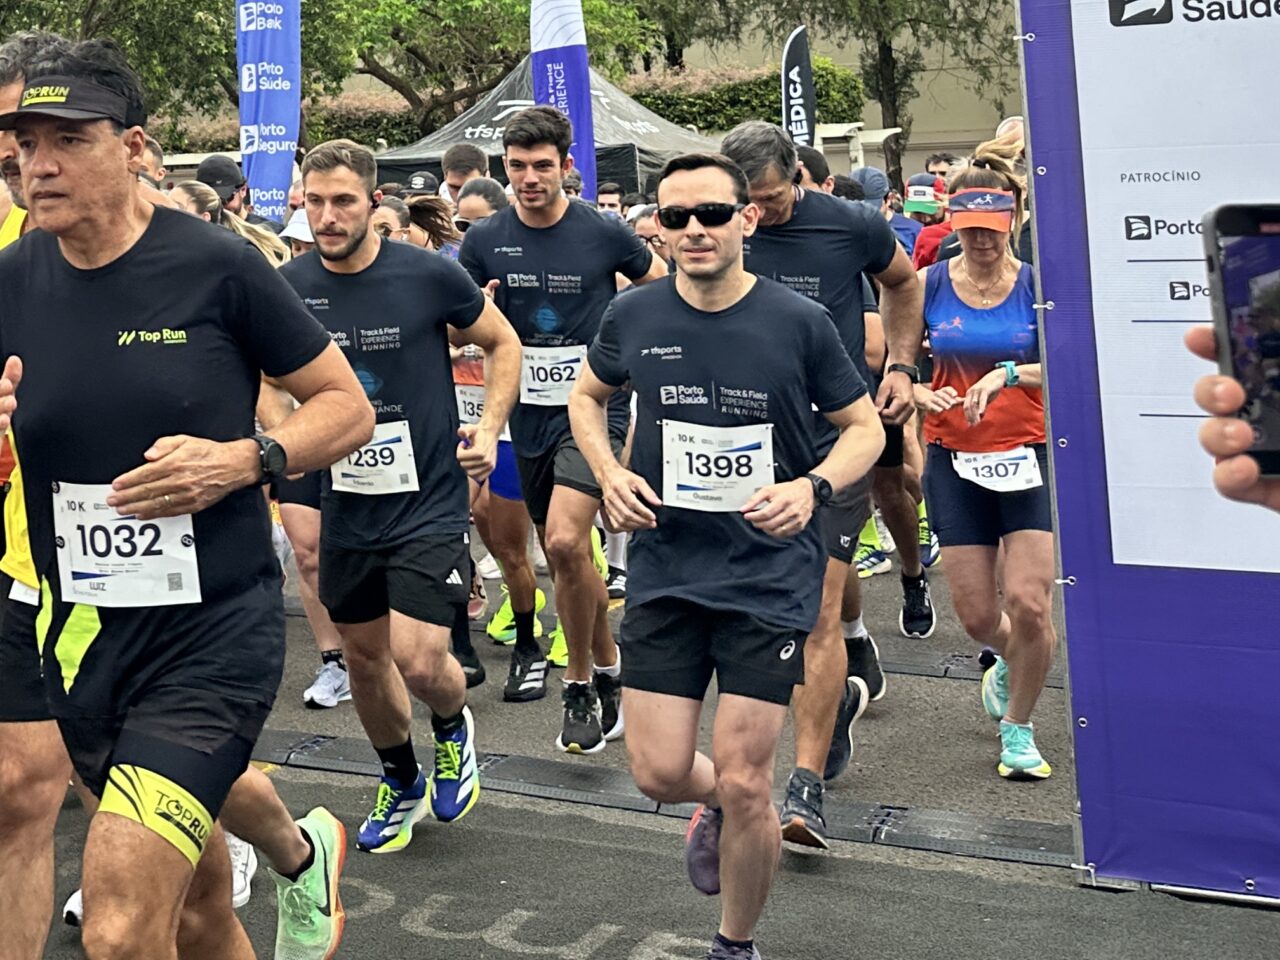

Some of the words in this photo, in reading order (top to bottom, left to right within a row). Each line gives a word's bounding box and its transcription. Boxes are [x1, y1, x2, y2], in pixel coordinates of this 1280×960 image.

[553, 61, 570, 117] ERIENCE
[464, 124, 506, 140] tfsp
[1120, 169, 1201, 184] PATROCÍNIO
[254, 187, 285, 202] Porto
[138, 330, 161, 343] Top
[162, 328, 186, 340] Run
[529, 365, 576, 383] 1062
[678, 385, 704, 395] Porto
[377, 404, 403, 414] ANDE
[462, 399, 484, 418] 135
[721, 406, 768, 419] RUNNING
[685, 451, 753, 478] 1398
[972, 462, 1020, 479] 1307
[66, 500, 77, 512] 10
[78, 501, 86, 513] K
[76, 522, 163, 558] 1032
